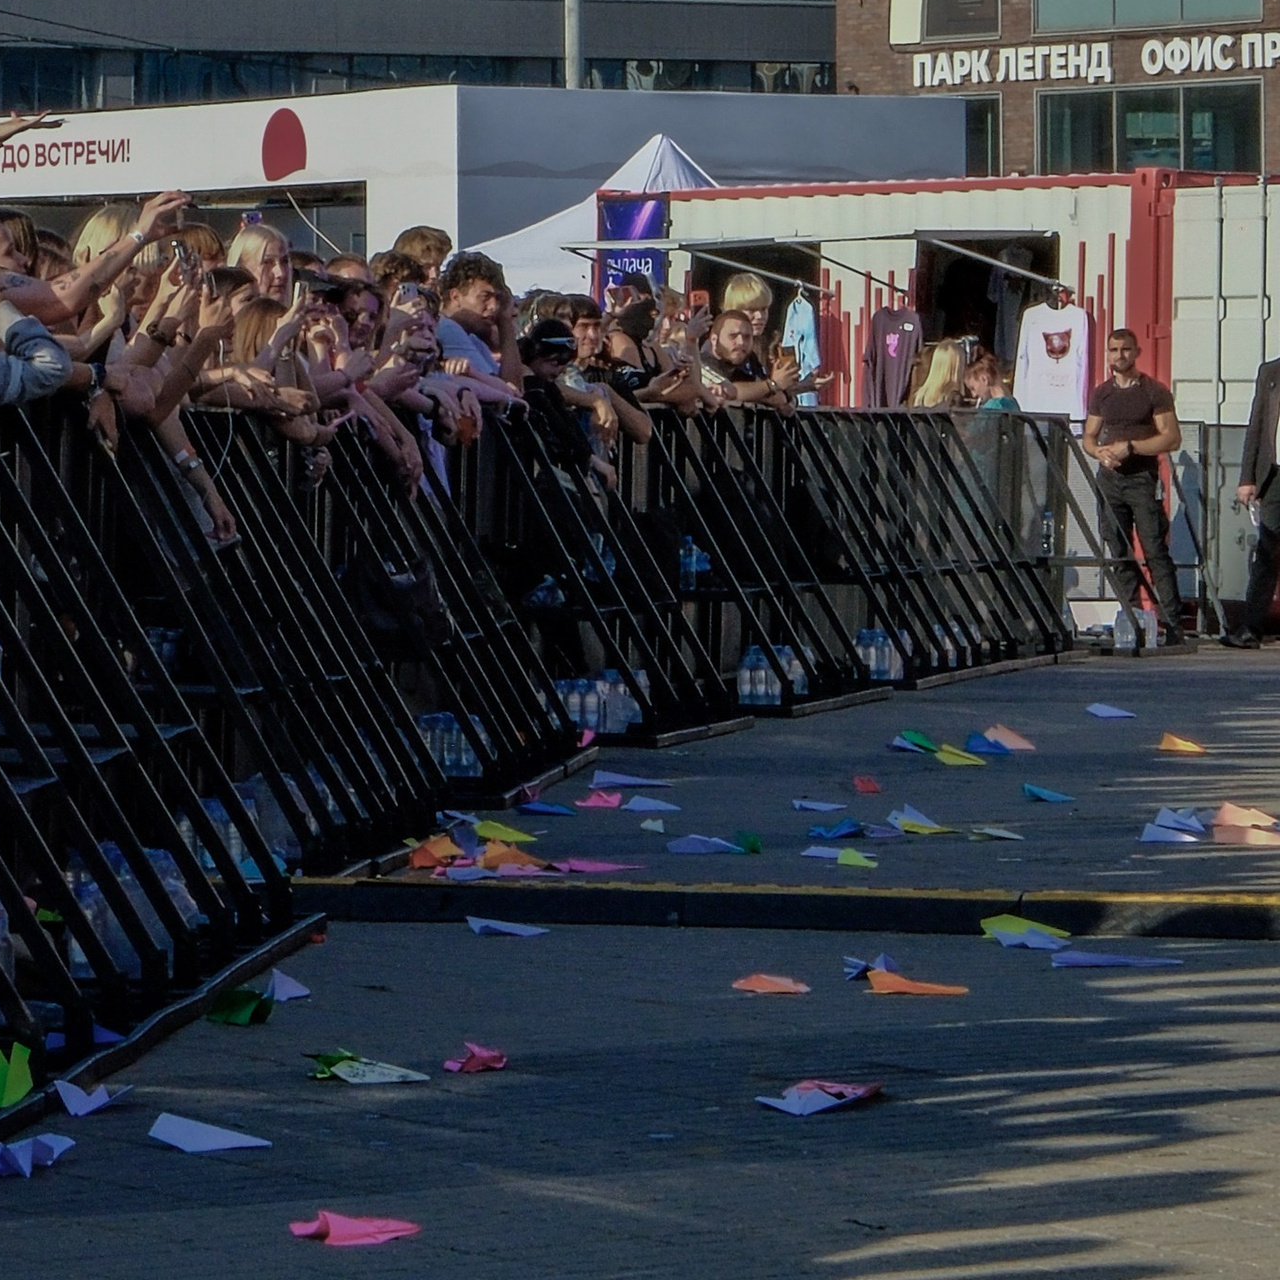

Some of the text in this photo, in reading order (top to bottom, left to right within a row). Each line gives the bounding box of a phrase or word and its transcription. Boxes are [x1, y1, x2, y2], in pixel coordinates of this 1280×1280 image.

[913, 43, 1113, 87] ПАРК ЛЕГЕНД
[1141, 35, 1236, 75] ОФИС
[1, 143, 30, 173] ДО
[34, 138, 131, 167] ВСТРЕЧИ!
